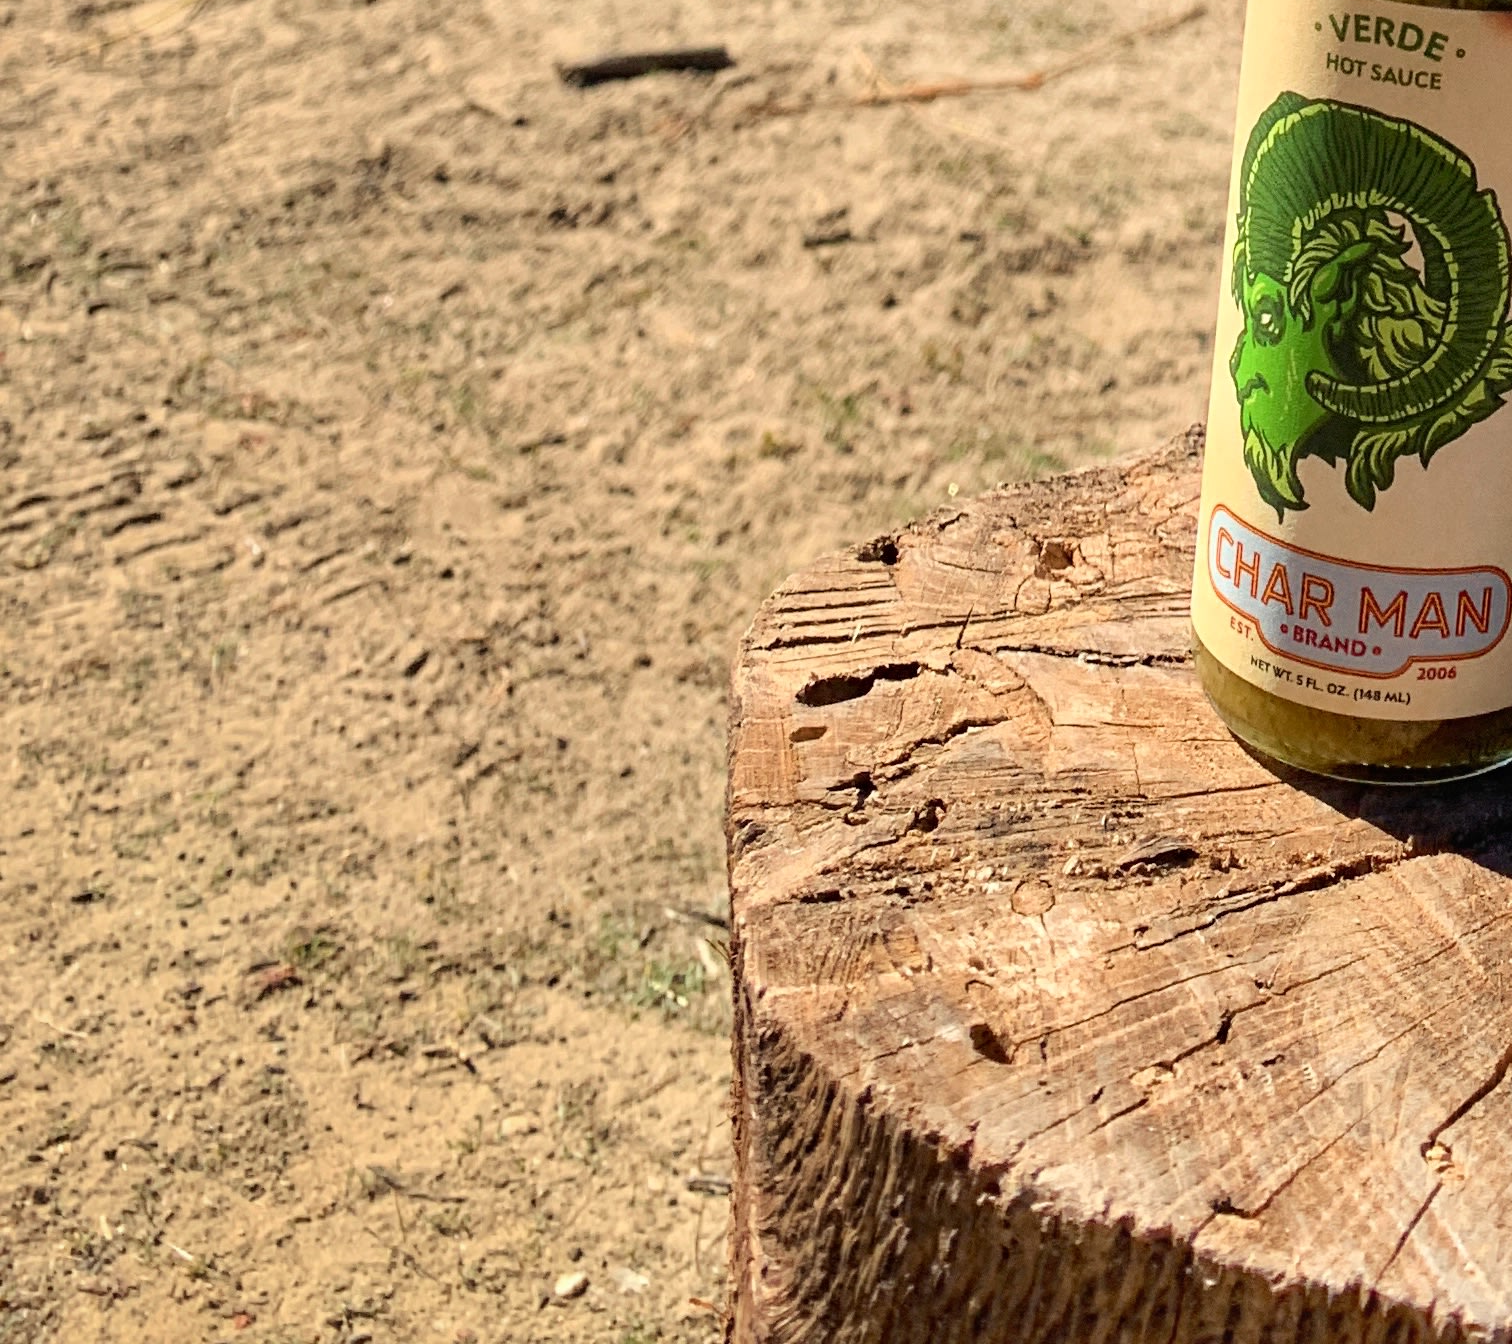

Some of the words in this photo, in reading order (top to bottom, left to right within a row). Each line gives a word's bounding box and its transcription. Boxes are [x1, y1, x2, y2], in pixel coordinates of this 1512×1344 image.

[1328, 13, 1449, 62] VERDE
[1326, 52, 1367, 77] HOT
[1370, 64, 1442, 90] SAUCE
[1215, 526, 1335, 627] CHAR
[1358, 586, 1493, 640] MAN
[1229, 616, 1254, 641] EST.
[1416, 666, 1457, 681] 2006
[1293, 624, 1367, 657] BRAND
[1250, 655, 1271, 673] NET
[1273, 665, 1293, 682] WT.
[1296, 675, 1304, 686] 5
[1306, 677, 1324, 691] FL.
[1327, 683, 1350, 697] OZ.
[1353, 687, 1381, 702] (148
[1384, 692, 1411, 706] ML)
